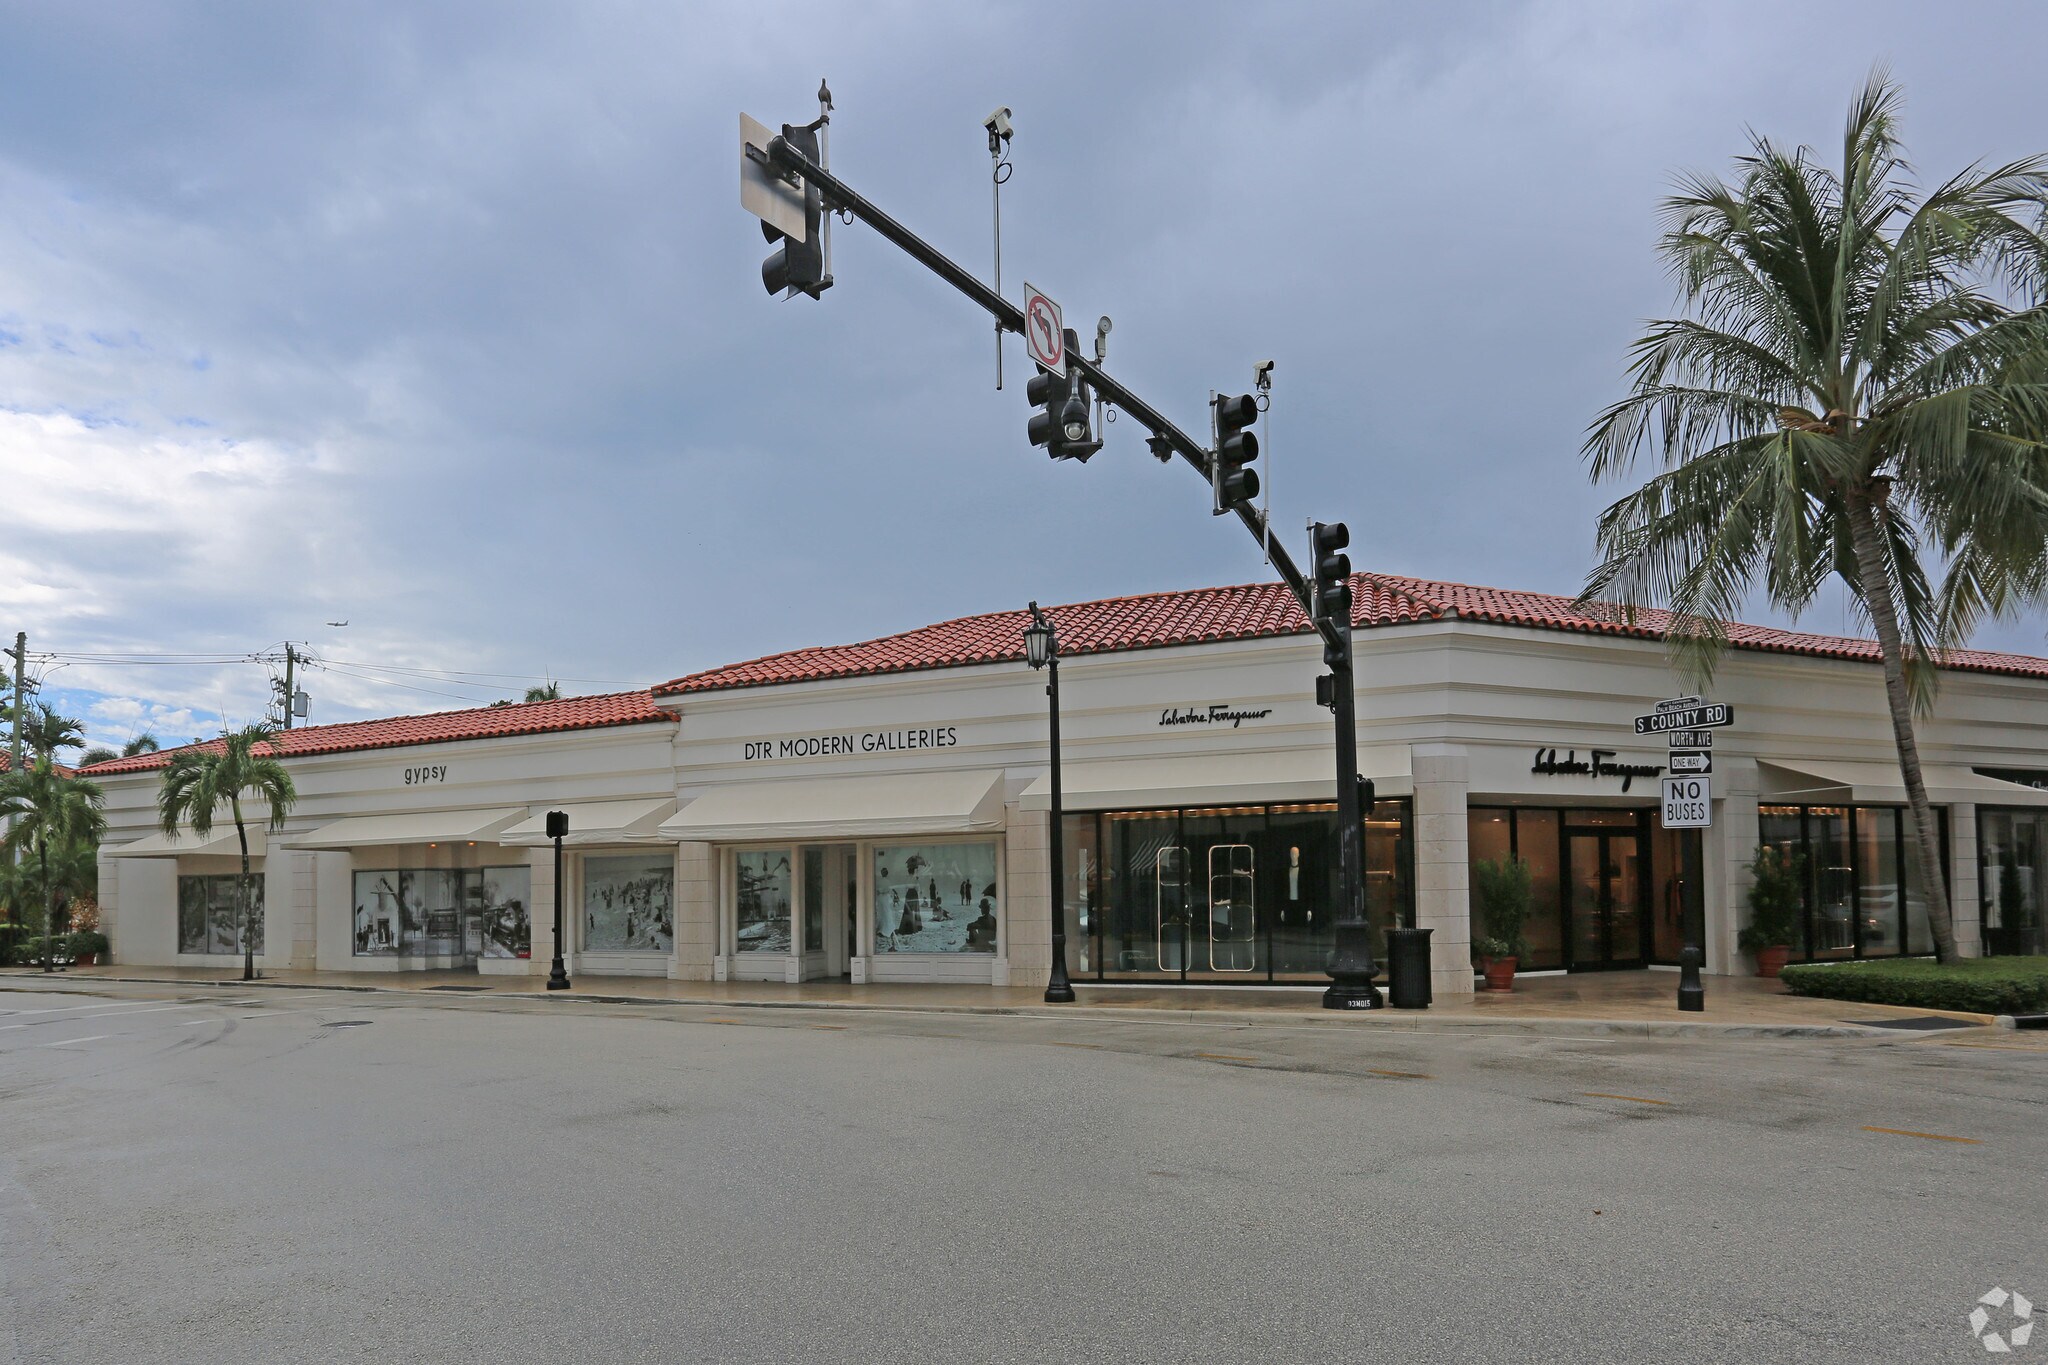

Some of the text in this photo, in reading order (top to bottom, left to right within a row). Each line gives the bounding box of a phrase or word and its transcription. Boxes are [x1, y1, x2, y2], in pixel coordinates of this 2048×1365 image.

[1159, 705, 1272, 728] Salvatore Ferragamo
[1637, 706, 1723, 732] S COUNTY RD
[745, 727, 957, 760] DTR MODERN GALLERIES
[1670, 732, 1711, 746] WORTH AVE
[1673, 756, 1700, 768] ONE WAY
[404, 765, 447, 785] gypsy
[1671, 781, 1701, 800] NO
[1667, 802, 1705, 821] BUSES
